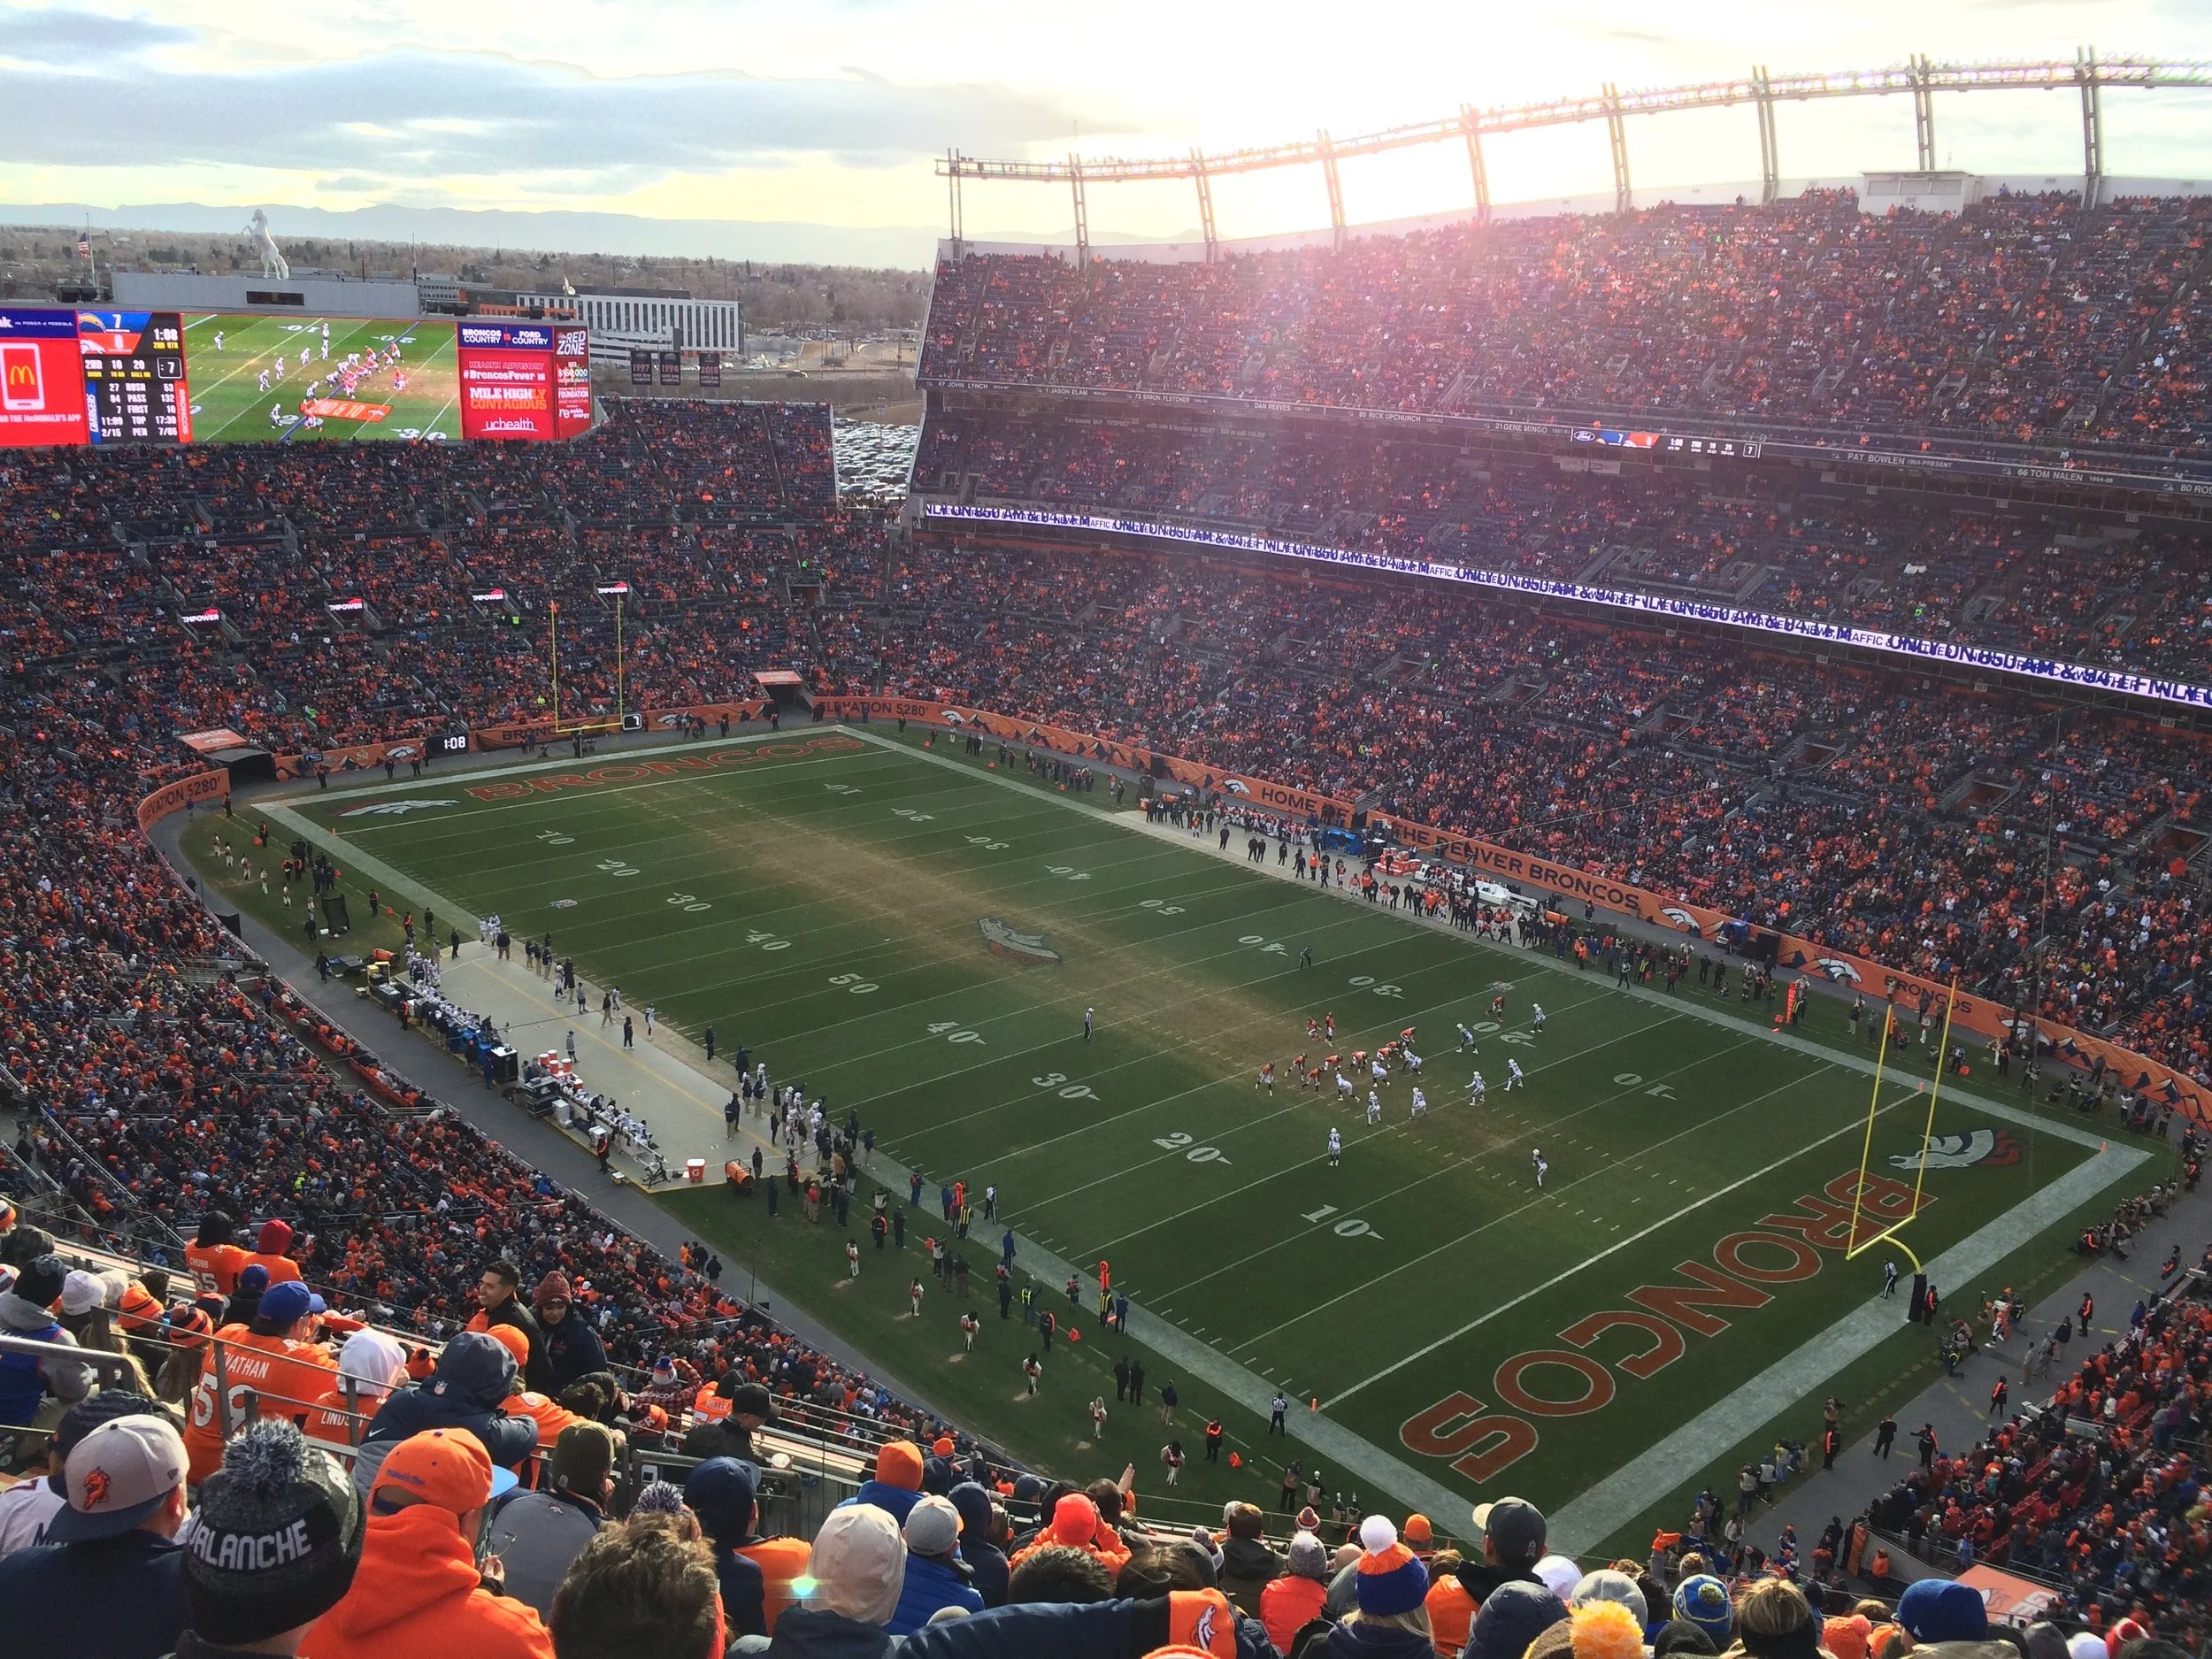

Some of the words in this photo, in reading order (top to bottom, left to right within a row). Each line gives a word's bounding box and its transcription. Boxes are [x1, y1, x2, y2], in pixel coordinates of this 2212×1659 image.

[112, 313, 122, 329] 7
[463, 328, 502, 337] BRONCOS
[566, 330, 587, 342] RED
[557, 340, 585, 355] ZONE
[85, 359, 103, 370] 2ND
[464, 370, 534, 380] #BroncosFever
[127, 394, 147, 403] PASS
[470, 388, 503, 399] MILE
[503, 388, 547, 400] HIGHLY
[116, 405, 122, 414] 7
[127, 404, 149, 414] FIRST
[179, 388, 189, 435] BRONCOS
[470, 399, 547, 410] CONTAGIOUS
[9, 414, 23, 423] THE
[132, 416, 147, 426] TOP
[486, 417, 534, 429] uchealth
[1385, 413, 1421, 423] UPCHURCH
[133, 427, 149, 437] PEN
[1578, 432, 1593, 441] Ford
[1617, 433, 1624, 443] 7
[1847, 452, 1864, 461] PAT
[1868, 454, 1905, 465] BOWLEN
[2017, 468, 2028, 477] 66
[2031, 469, 2050, 479] TOM
[2052, 471, 2084, 481] NALEN
[634, 716, 641, 726] 7
[444, 735, 466, 750] 1:08
[464, 737, 865, 802] BRONCOS
[187, 776, 221, 797] 5280'
[826, 784, 863, 795] 10
[1261, 787, 1317, 814] HOME
[892, 808, 935, 822] 20
[536, 830, 575, 845] 10
[966, 835, 1010, 850] 30
[595, 859, 641, 877] 20
[1048, 865, 1092, 880] 40
[1393, 822, 1430, 846] THE
[1529, 864, 1640, 910] BRONCOS
[667, 893, 712, 912] 30
[1139, 899, 1187, 916] 50
[745, 930, 792, 951] 40
[1238, 935, 1286, 953] 40
[828, 972, 879, 994] 50
[1348, 976, 1403, 996] 30
[926, 1020, 980, 1043] 40
[1472, 1021, 1532, 1046] 20
[1032, 1072, 1094, 1100] 30
[1613, 1072, 1674, 1098] 10
[1152, 1132, 1225, 1164] 20
[1300, 1203, 1375, 1239] 10
[190, 1256, 209, 1269] CHUBB
[1399, 1168, 1939, 1485] BRONCOS
[706, 1397, 729, 1412] MILLER
[320, 1410, 367, 1428] LINDSY
